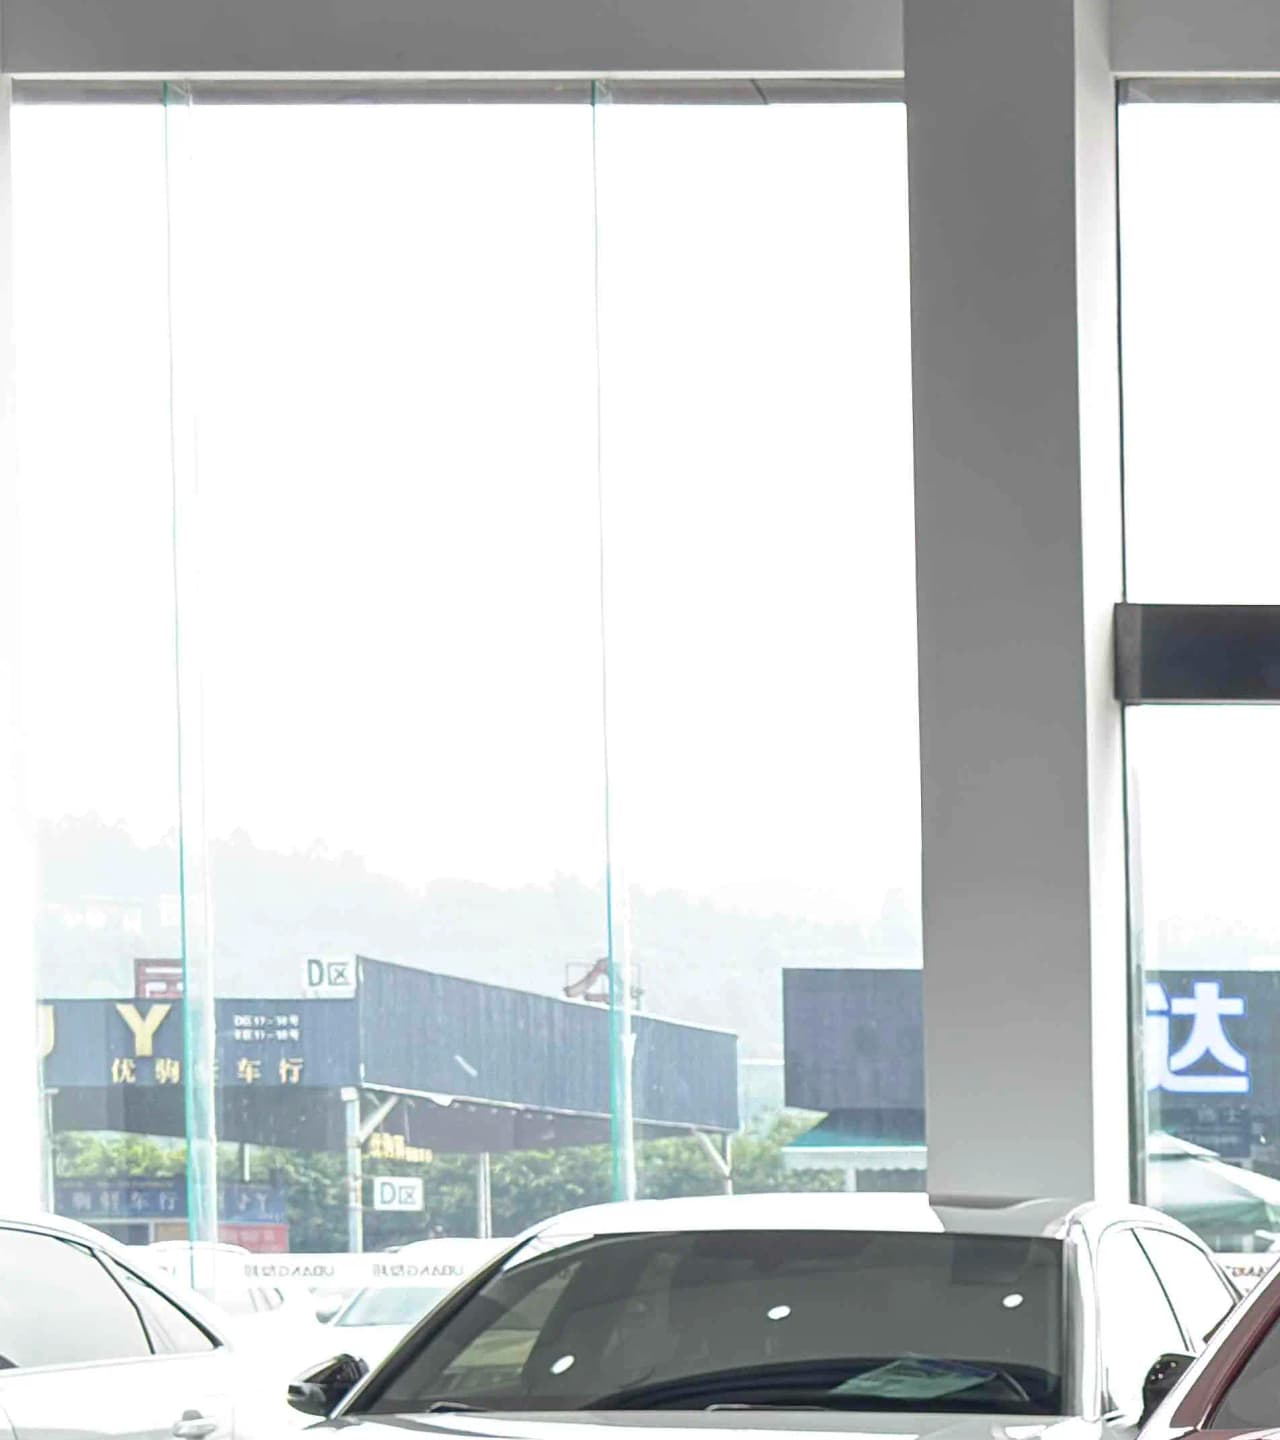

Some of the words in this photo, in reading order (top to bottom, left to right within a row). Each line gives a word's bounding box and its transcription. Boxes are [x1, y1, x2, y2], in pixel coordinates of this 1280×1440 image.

[307, 959, 351, 987] D区
[111, 1057, 304, 1084] 优驹车行
[379, 1181, 417, 1206] D区
